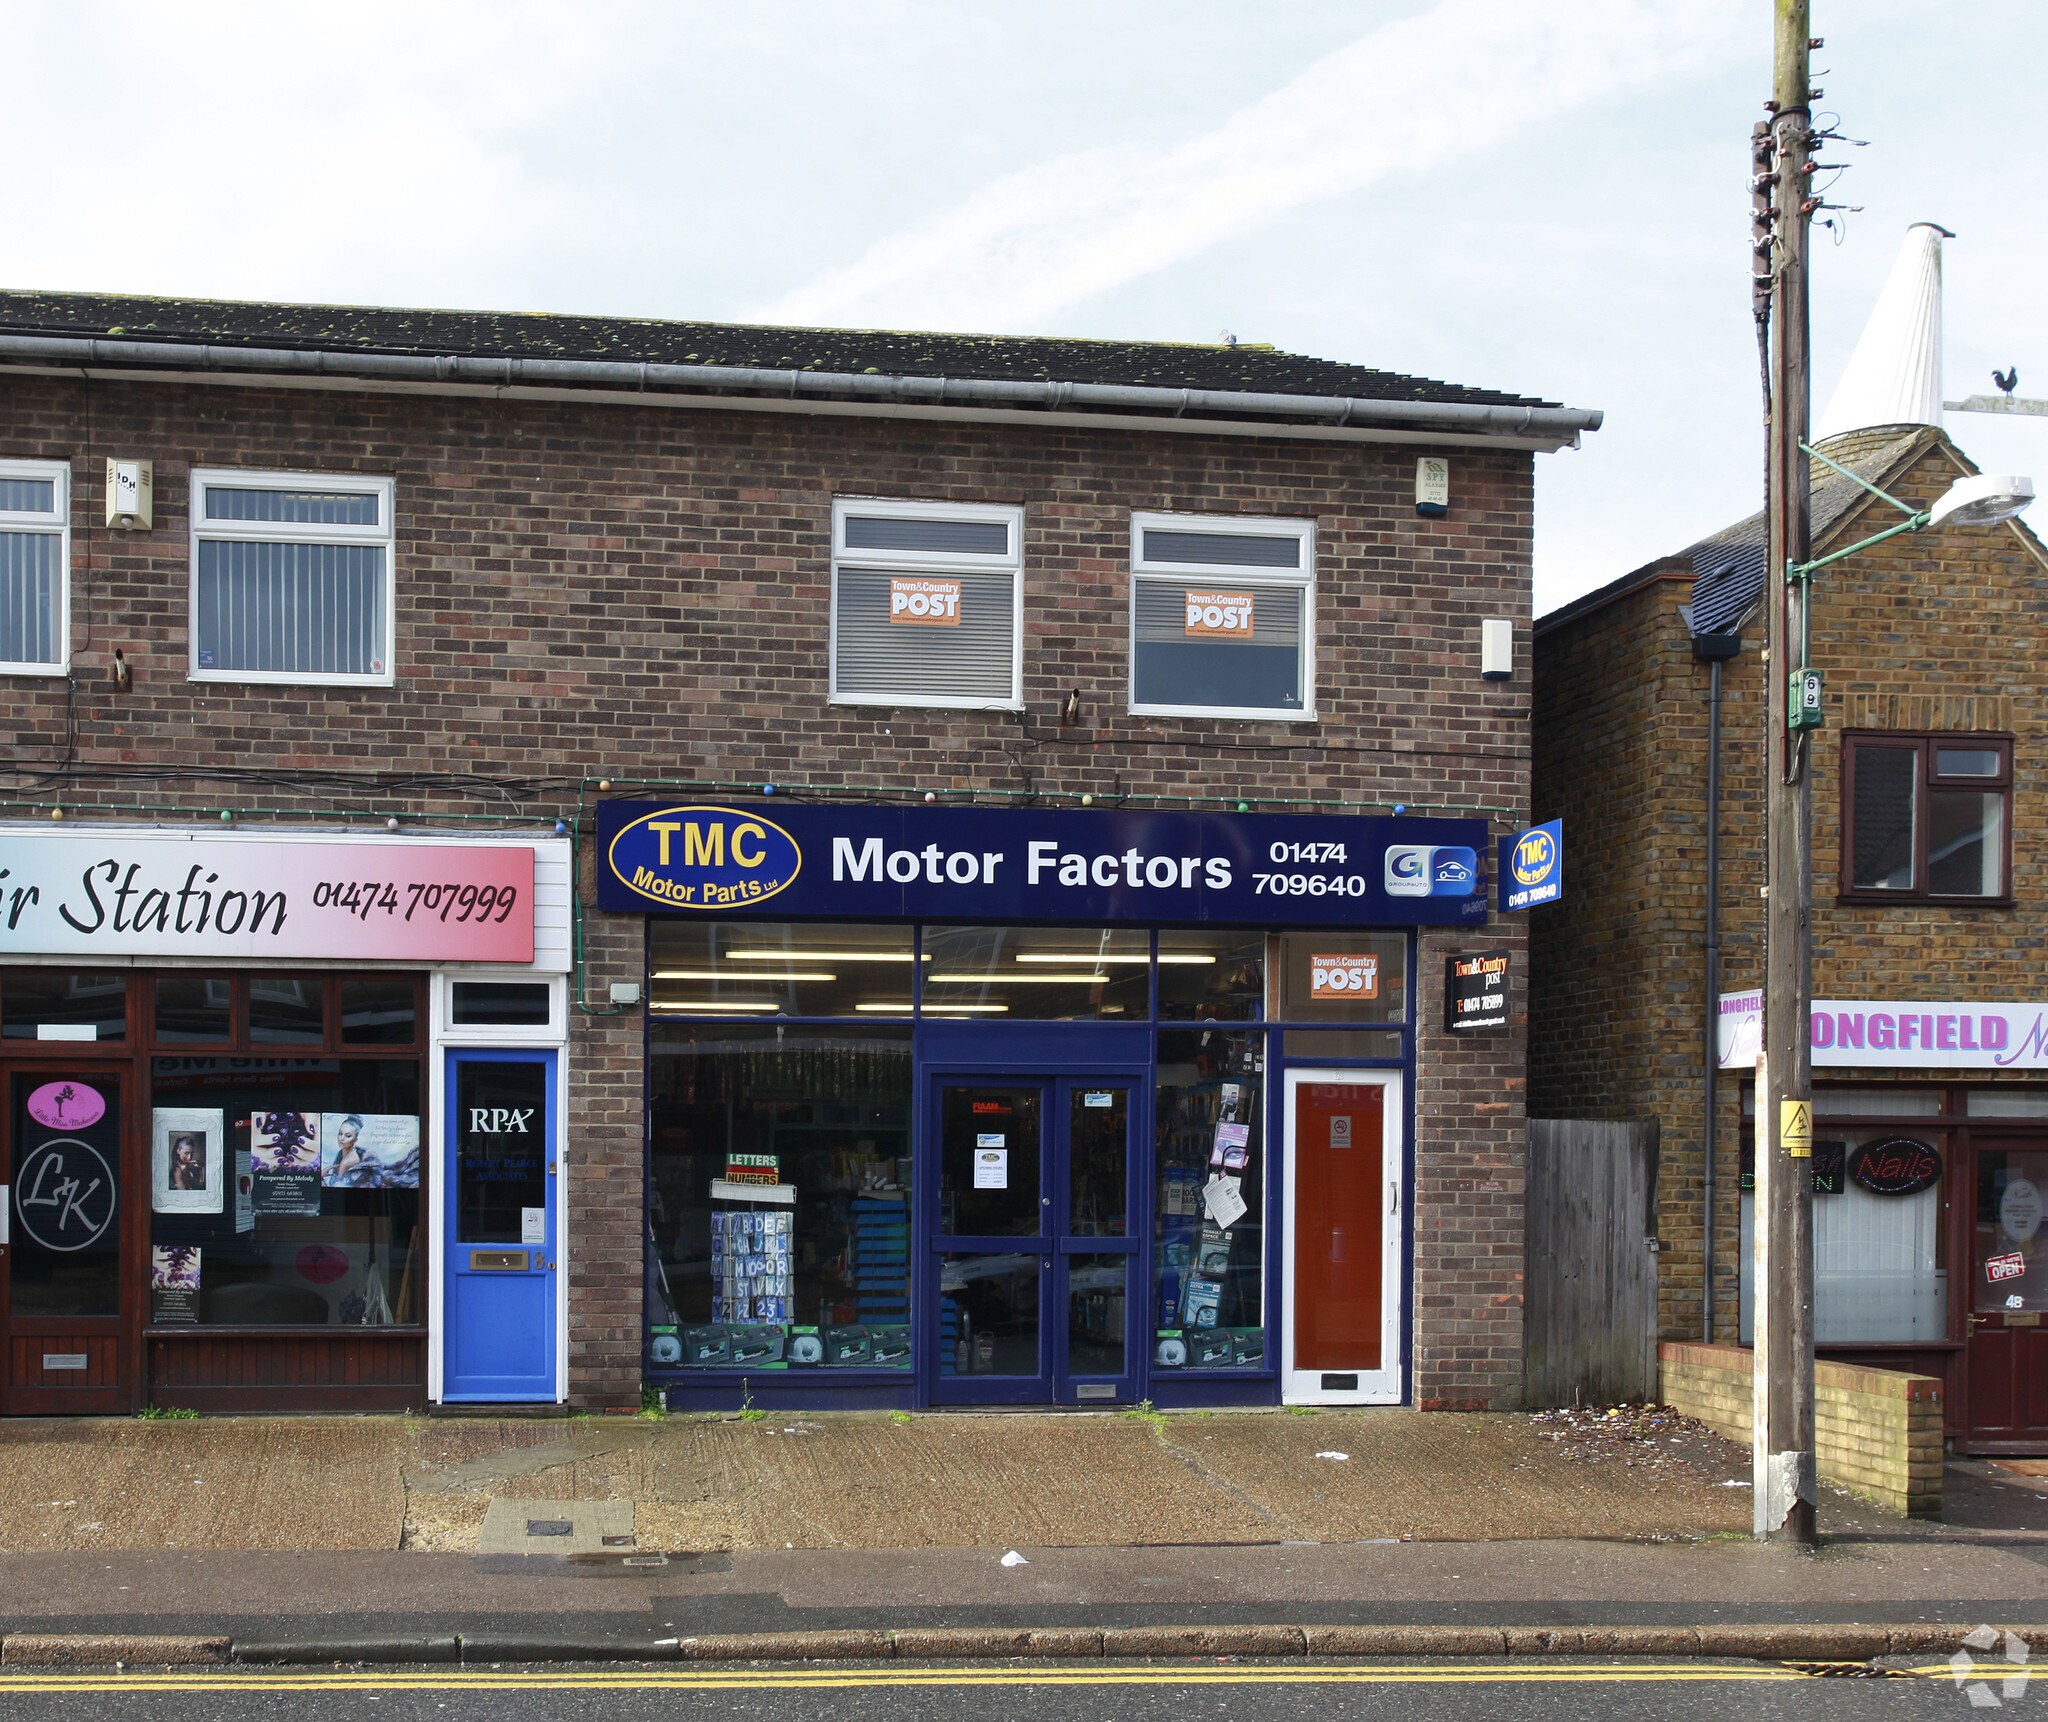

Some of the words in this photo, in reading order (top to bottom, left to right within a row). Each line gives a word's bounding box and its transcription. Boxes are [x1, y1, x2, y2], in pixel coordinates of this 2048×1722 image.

[1426, 472, 1445, 481] SPY
[892, 580, 959, 594] Town&Country
[892, 592, 960, 617] POST
[1187, 593, 1252, 608] Town&Country
[1187, 604, 1253, 629] POST
[648, 821, 767, 868] TMC
[1269, 841, 1347, 864] 01474
[1520, 837, 1547, 867] TMC
[832, 836, 1004, 885] Motor
[1028, 840, 1232, 890] Factors
[1517, 866, 1532, 881] Motor
[632, 865, 696, 902] Motor
[703, 880, 762, 903] Parts
[763, 879, 778, 891] Ltd
[1252, 873, 1366, 897] 709640
[1509, 890, 1529, 907] 01474
[1530, 883, 1557, 903] 709640
[59, 858, 287, 935] Station
[312, 881, 398, 921] 01474
[404, 883, 517, 923] 707999
[1312, 957, 1376, 969] Town&Country
[1455, 957, 1508, 976] Town&Country
[1312, 968, 1377, 990] POST
[1485, 972, 1501, 990] post
[1811, 1012, 2008, 1050] ONGFIELD
[470, 1109, 534, 1133] RPA
[729, 1154, 777, 1166] LETTERS
[1857, 1152, 1936, 1179] Nails
[294, 1175, 314, 1183] Melody
[727, 1173, 777, 1186] NUMBERS
[534, 1252, 545, 1271] 8
[1992, 1263, 2019, 1279] OPEN
[2005, 1295, 2023, 1308] 4B
